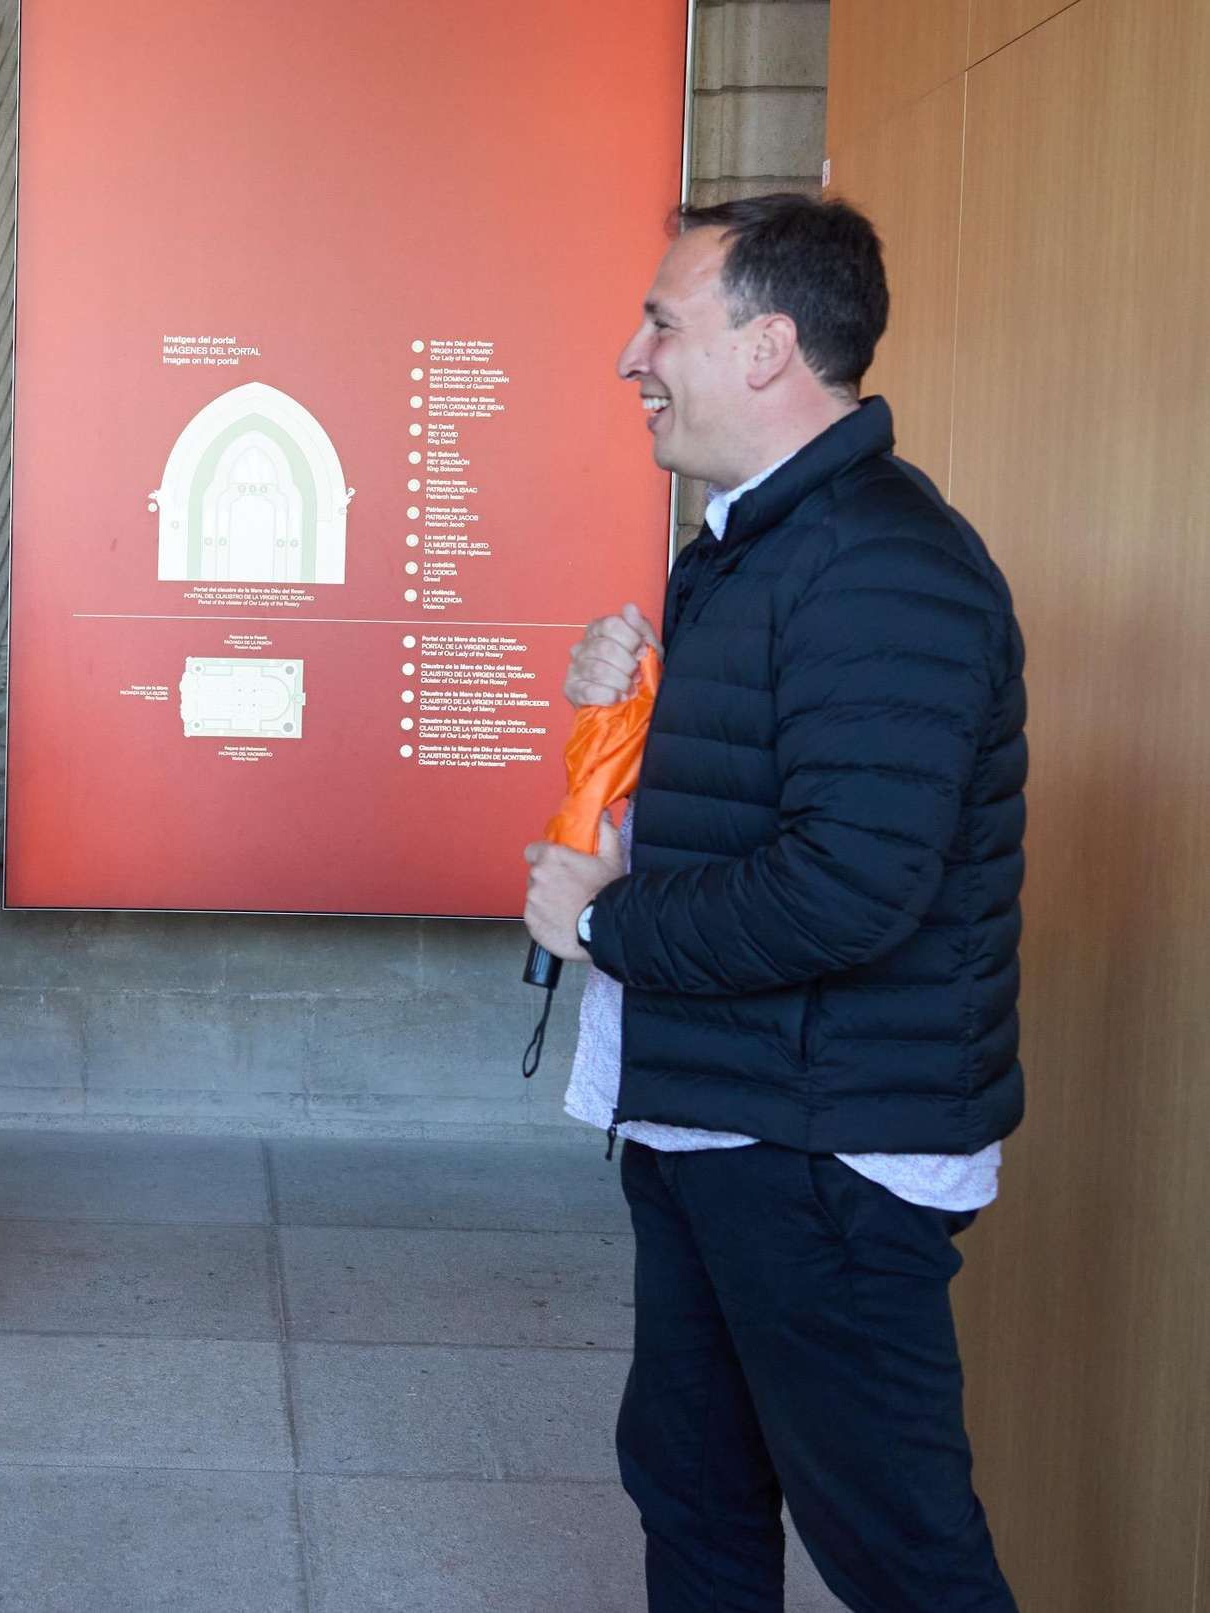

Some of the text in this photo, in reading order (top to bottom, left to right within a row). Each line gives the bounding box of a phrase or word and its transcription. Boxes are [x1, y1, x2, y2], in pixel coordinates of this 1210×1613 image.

[164, 335, 236, 345] Imatges del portal
[163, 345, 261, 356] IMÁGENES DEL PORTAL
[163, 355, 191, 366] Images
[203, 357, 216, 365] the
[217, 357, 239, 366] portal
